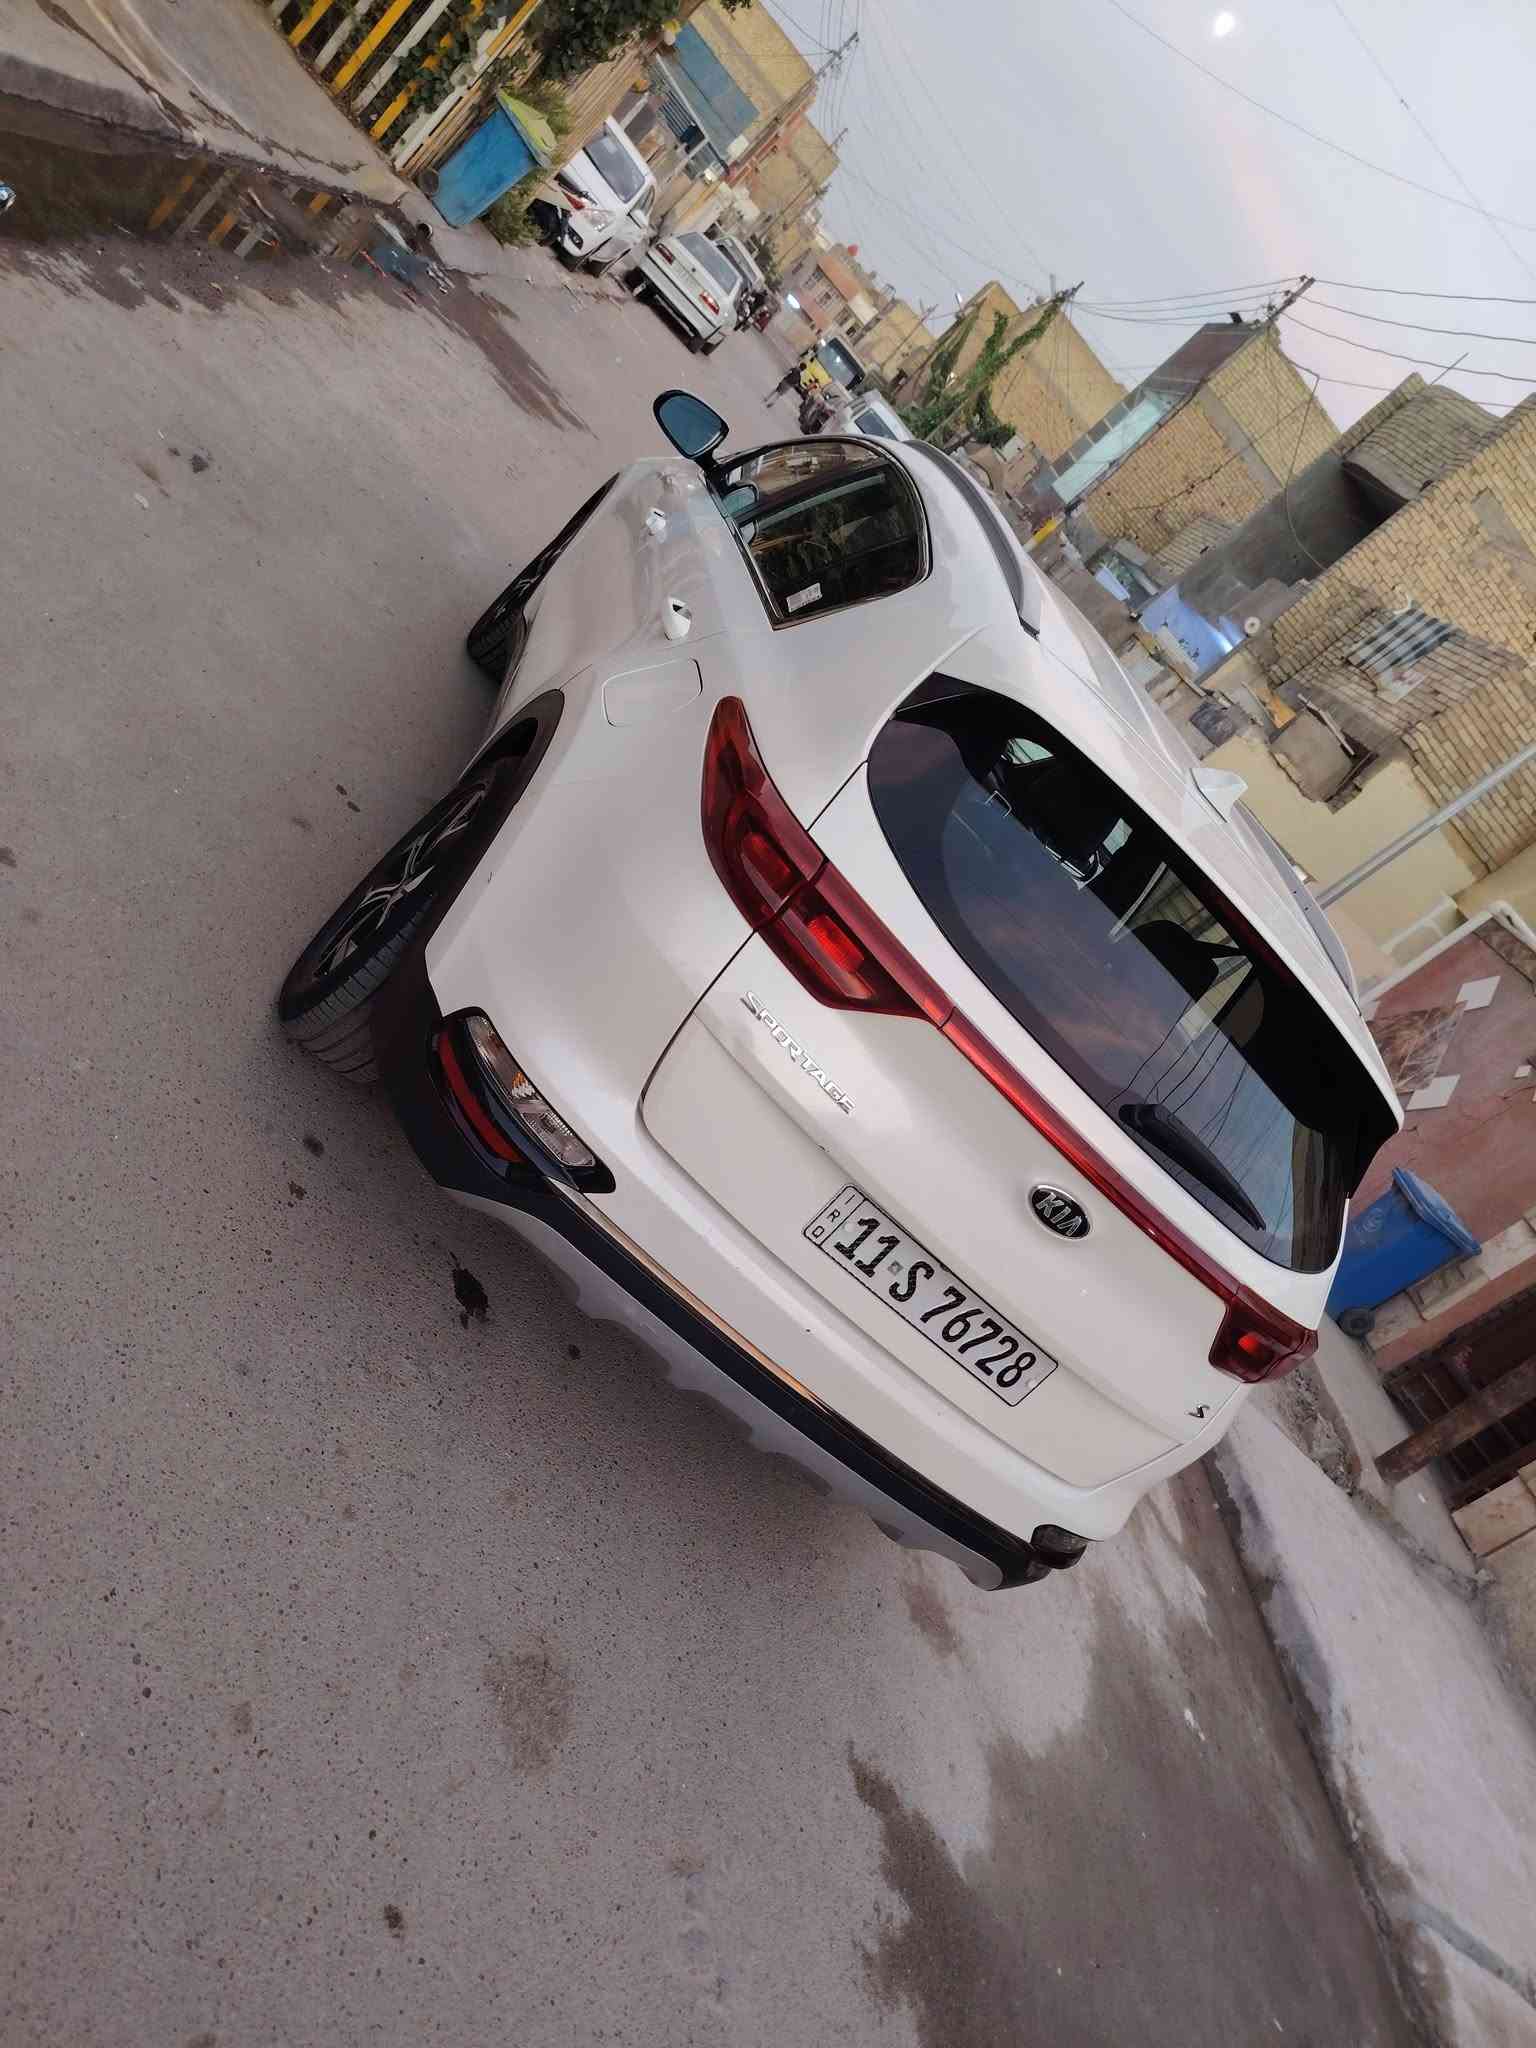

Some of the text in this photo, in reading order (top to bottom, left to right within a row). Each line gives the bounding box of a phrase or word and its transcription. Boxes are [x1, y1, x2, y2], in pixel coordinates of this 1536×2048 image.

[740, 991, 856, 1115] SPORTAGE
[1035, 1192, 1082, 1236] KIA
[834, 1217, 1037, 1389] 11 S 76728
